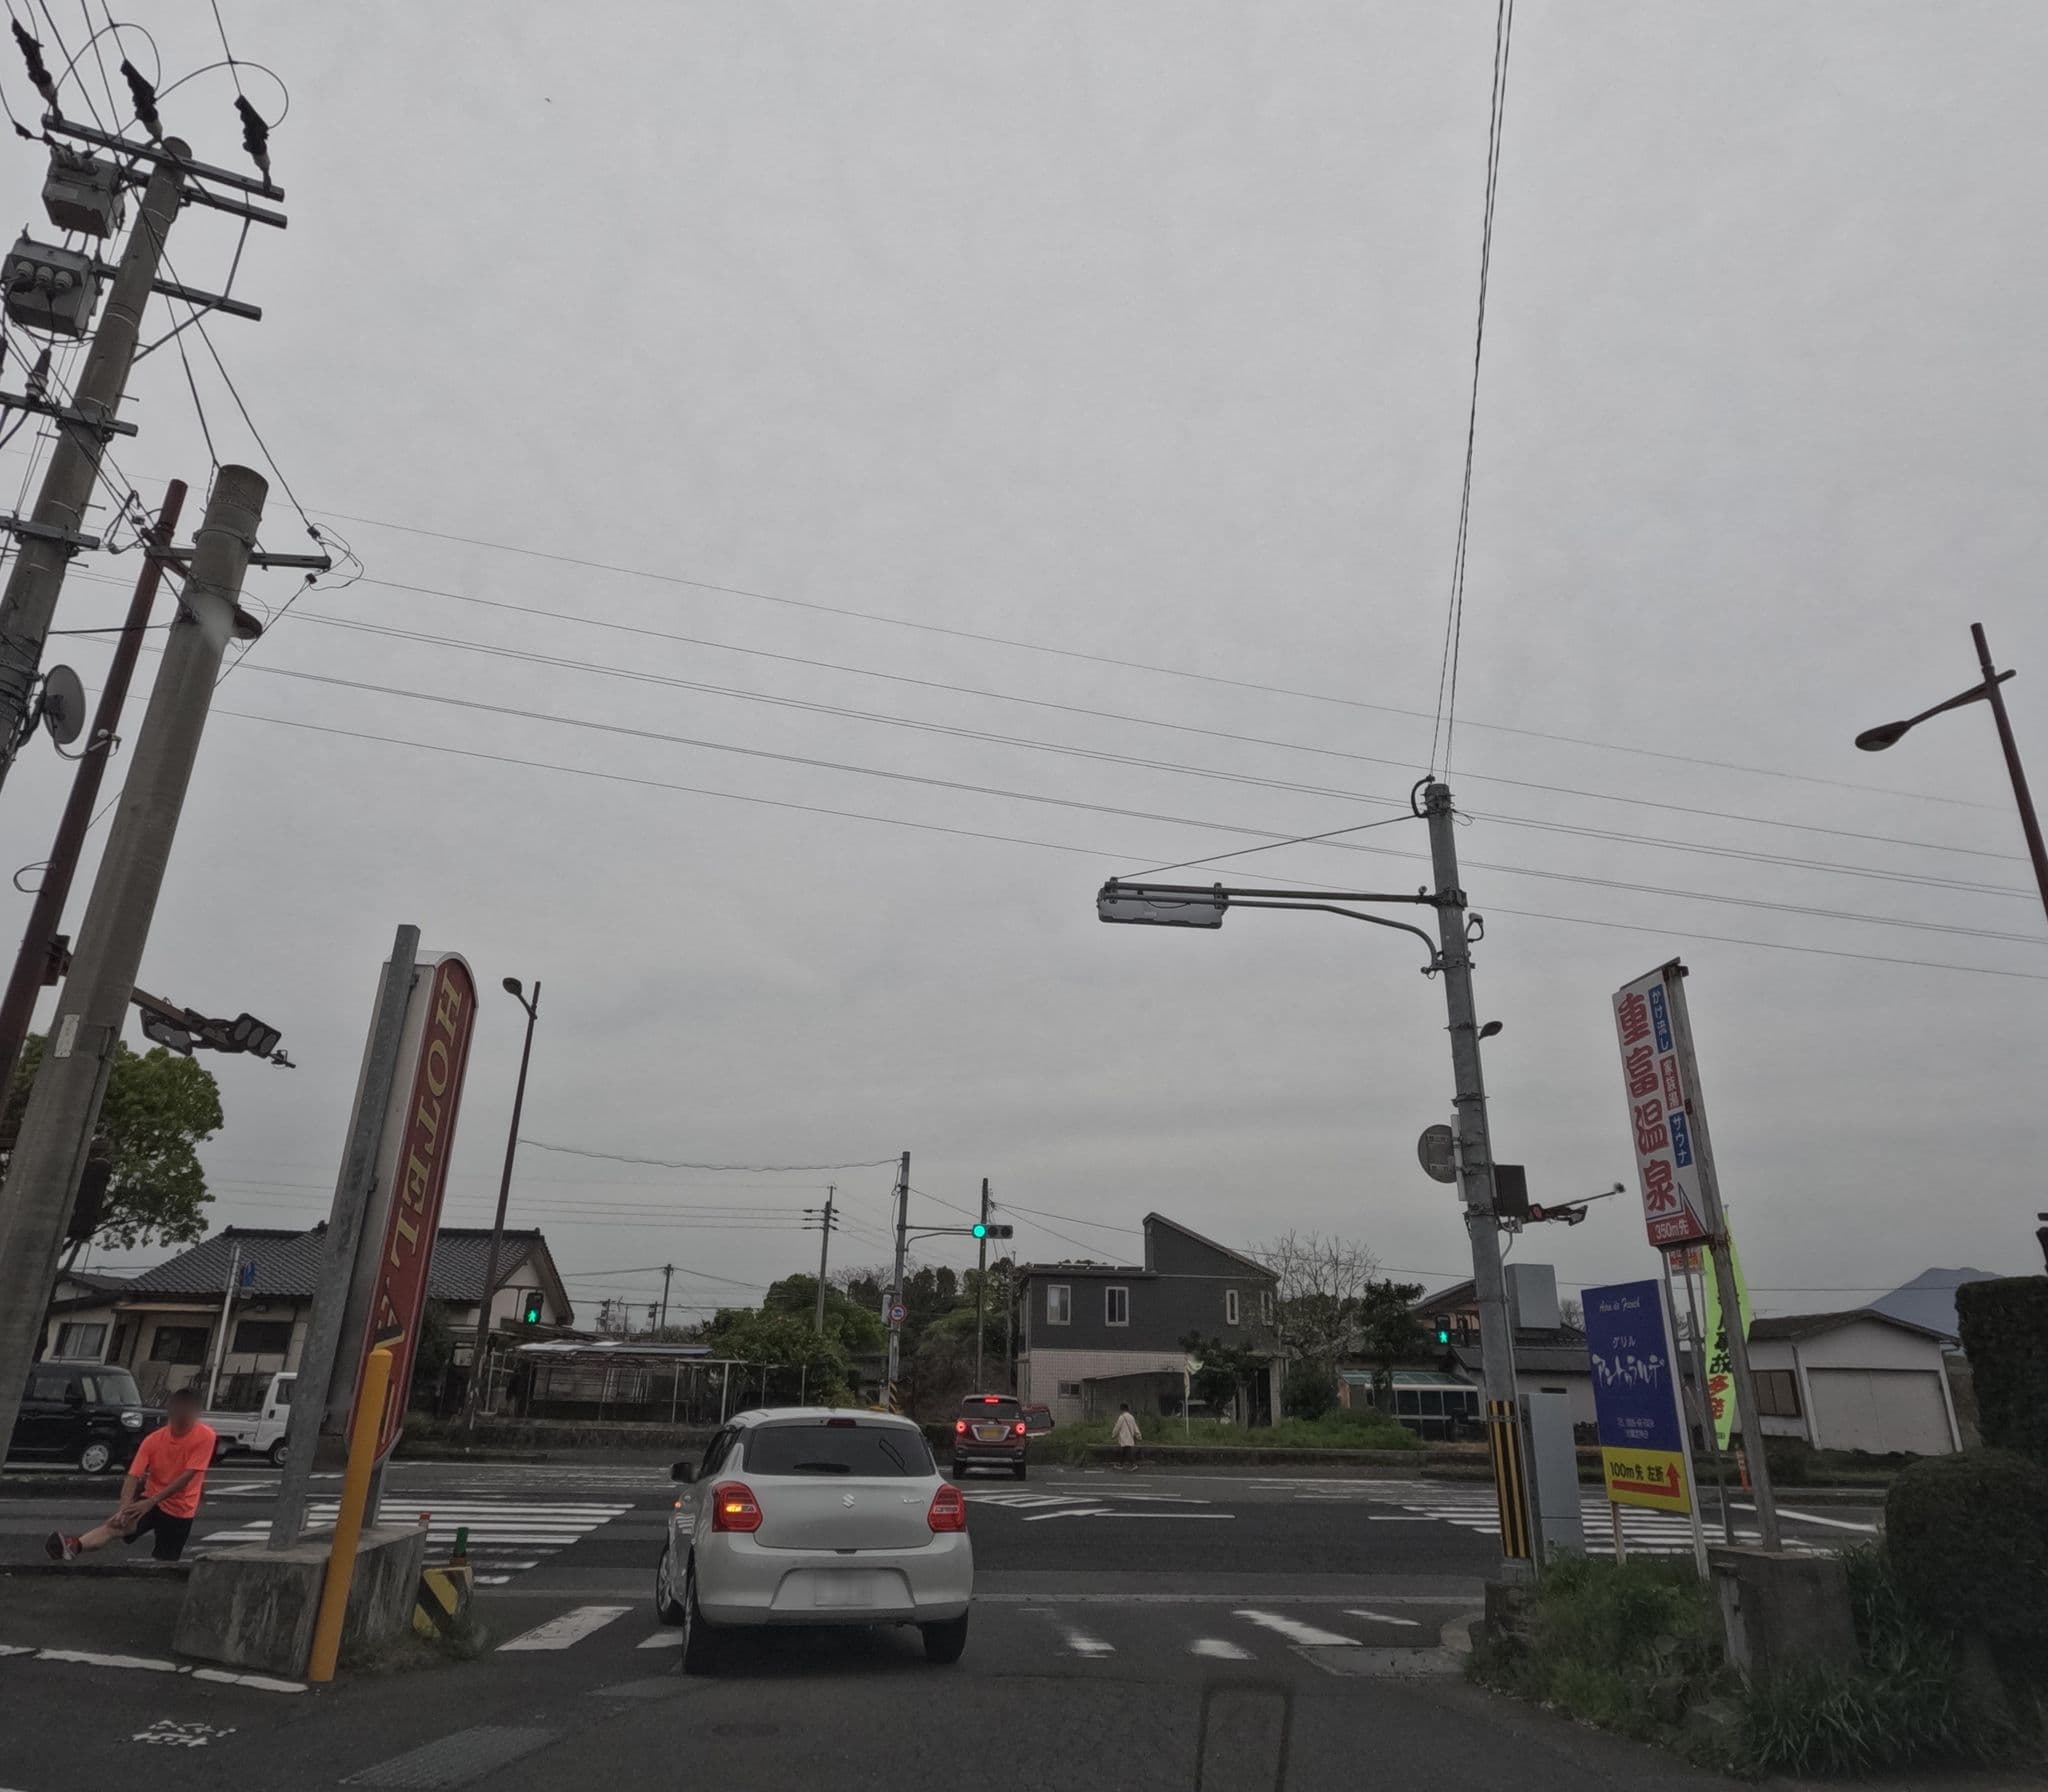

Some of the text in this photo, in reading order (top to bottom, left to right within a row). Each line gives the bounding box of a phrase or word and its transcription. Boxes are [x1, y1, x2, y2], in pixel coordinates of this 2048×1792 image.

[391, 968, 463, 1270] HOTEL
[1618, 992, 1678, 1212] 重富温泉
[1672, 1116, 1687, 1165] サウナ
[1655, 1219, 1689, 1240] 350m先
[1612, 1336, 1636, 1349] グリル
[1610, 1462, 1644, 1480] 100m先
